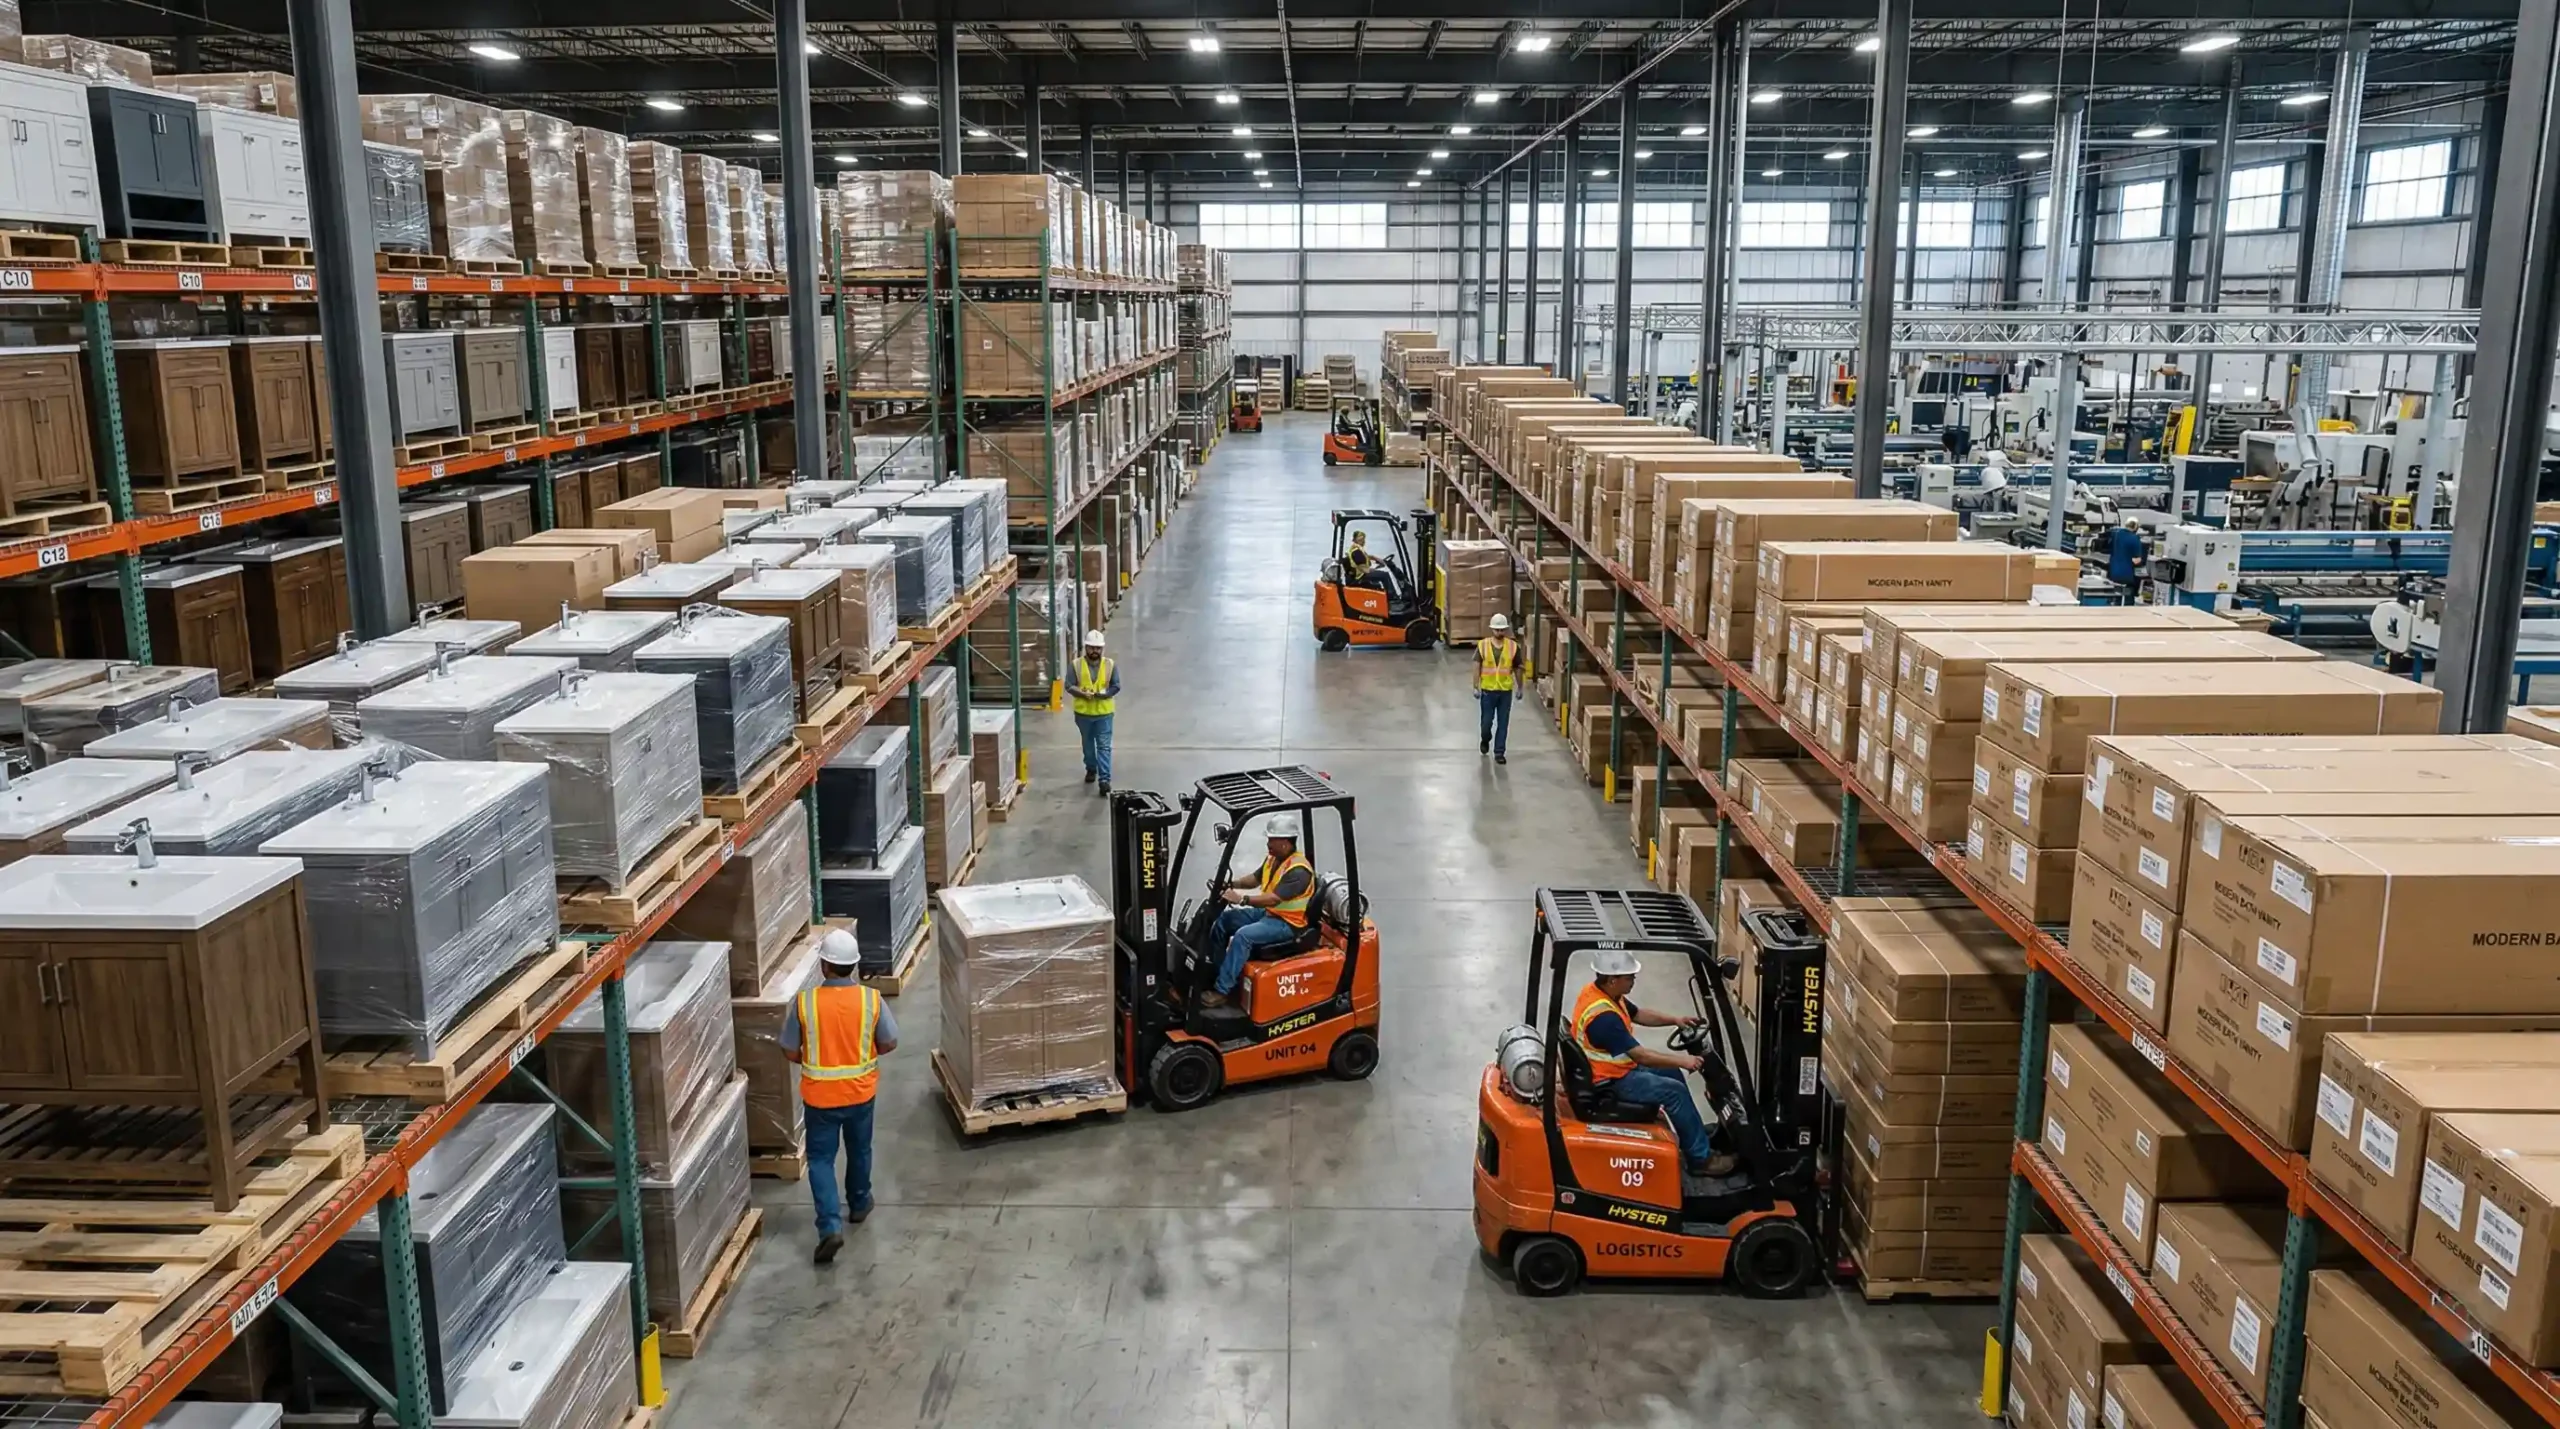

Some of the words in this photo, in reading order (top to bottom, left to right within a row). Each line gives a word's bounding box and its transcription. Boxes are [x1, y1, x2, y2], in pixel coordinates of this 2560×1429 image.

[3, 270, 29, 287] C10
[181, 274, 201, 288] C10
[1143, 831, 1155, 889] HYSTER
[2472, 932, 2541, 946] MODERN
[1276, 974, 1301, 985] UNIT
[1279, 984, 1296, 997] 04
[1802, 966, 1820, 1033] HYSTER
[1268, 1012, 1316, 1037] HYSTER
[1265, 1046, 1297, 1061] UNIT
[1300, 1043, 1316, 1055] 04
[1609, 1157, 1655, 1169] UNITTS
[1621, 1170, 1643, 1187] 09
[1608, 1204, 1668, 1226] HYSTER
[1596, 1242, 1684, 1258] LOGISTICS
